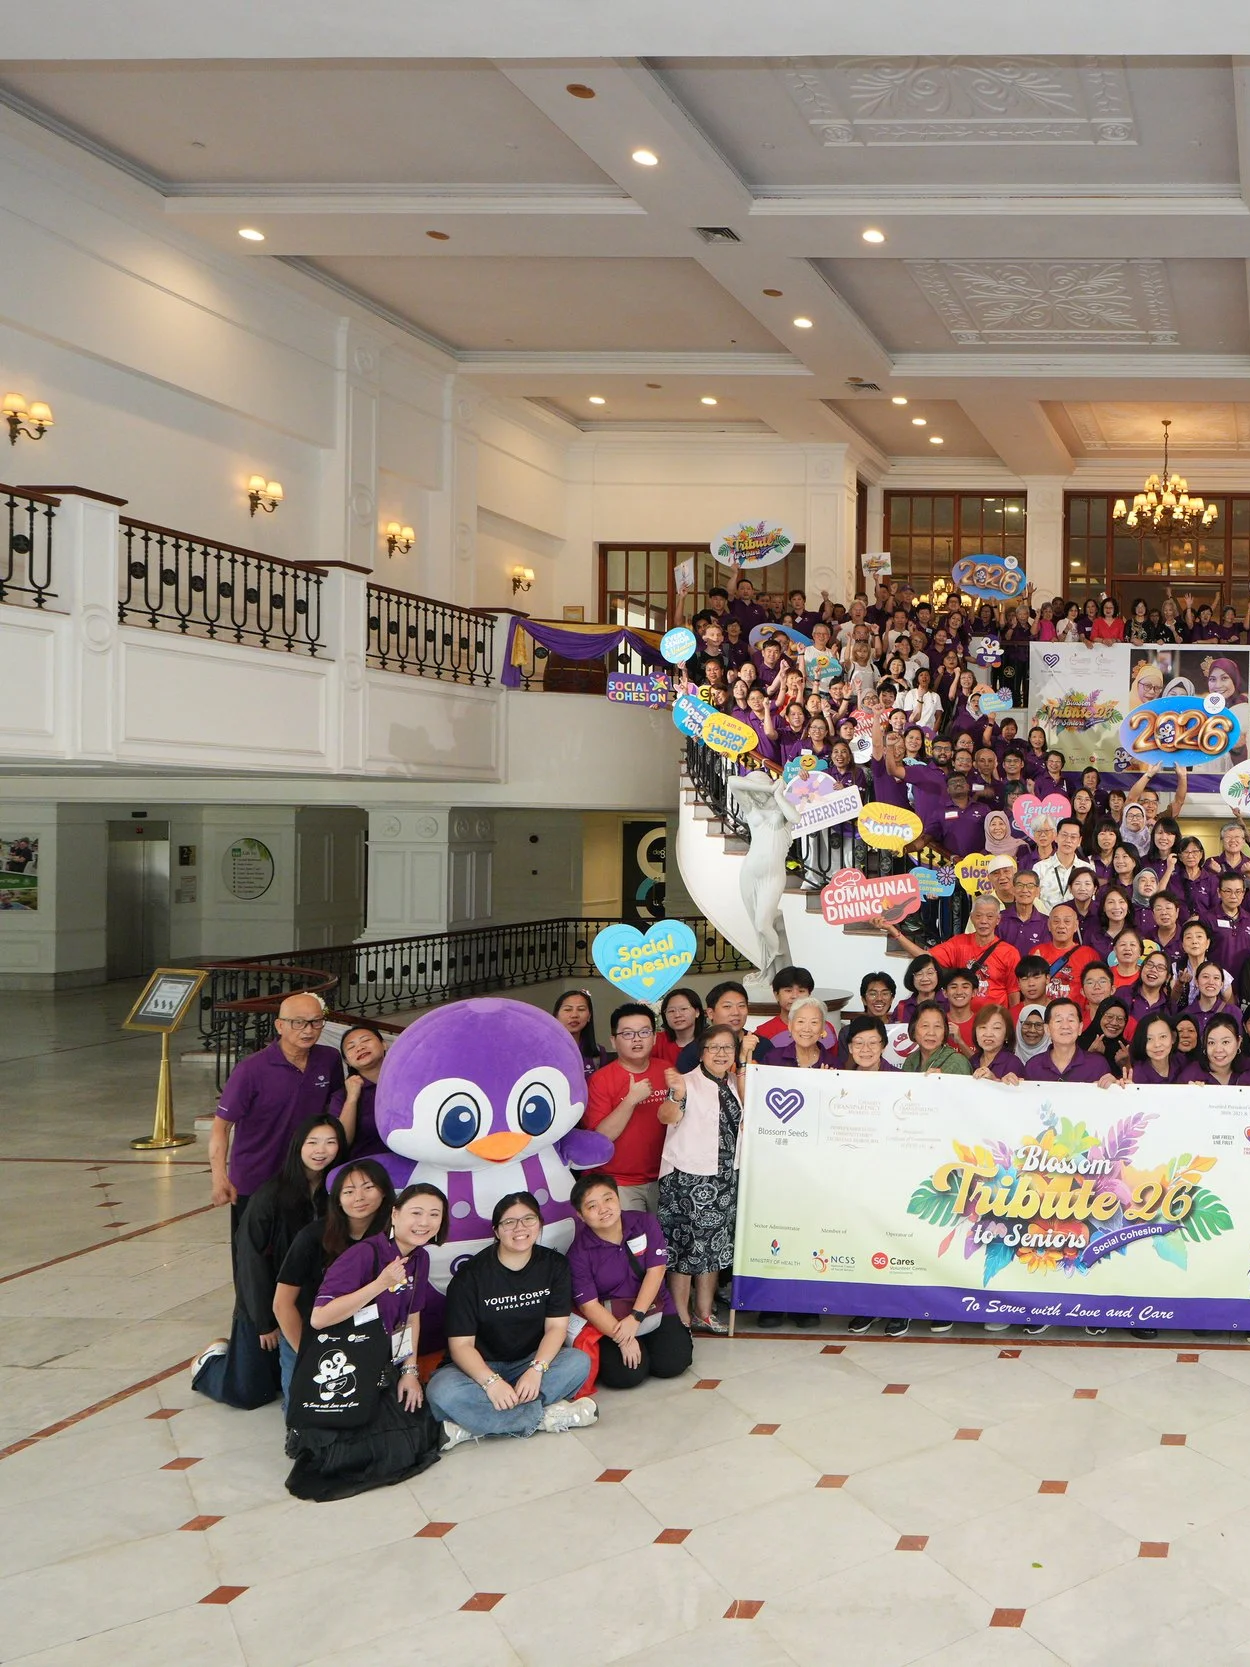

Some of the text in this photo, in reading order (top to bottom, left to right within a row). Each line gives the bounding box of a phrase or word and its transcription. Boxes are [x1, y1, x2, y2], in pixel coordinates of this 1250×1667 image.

[959, 560, 1022, 595] 2026
[608, 681, 649, 693] SOCIAL
[608, 692, 666, 703] COHESION
[679, 698, 705, 722] Bloss
[707, 733, 743, 752] Senior
[711, 724, 748, 746] Happy
[1129, 709, 1234, 755] 2026
[791, 795, 858, 831] ETHERNESS
[883, 812, 898, 821] feel
[1021, 800, 1063, 815] Tender
[862, 819, 914, 841] Young
[961, 866, 988, 878] Blos
[824, 877, 916, 906] COMMUNAL
[826, 900, 883, 921] DINING
[618, 934, 674, 963] Social
[608, 951, 692, 983] Cohesion
[758, 1127, 808, 1138] Blossom Seeds
[1017, 1145, 1114, 1175] Blossom
[932, 1161, 1194, 1222] Tribute 26
[754, 1222, 768, 1230] Sector
[973, 1223, 1087, 1249] to Seniors
[1093, 1225, 1163, 1255] Social Cohesion
[750, 1257, 773, 1265] MINISTRY
[831, 1256, 855, 1265] NCSS
[873, 1257, 886, 1265] SG
[890, 1257, 915, 1266] Cares
[484, 1288, 550, 1306] YOUTH CORPS
[496, 1299, 541, 1311] SINGAPORE
[962, 1297, 1174, 1320] To Serve with Love and Care
